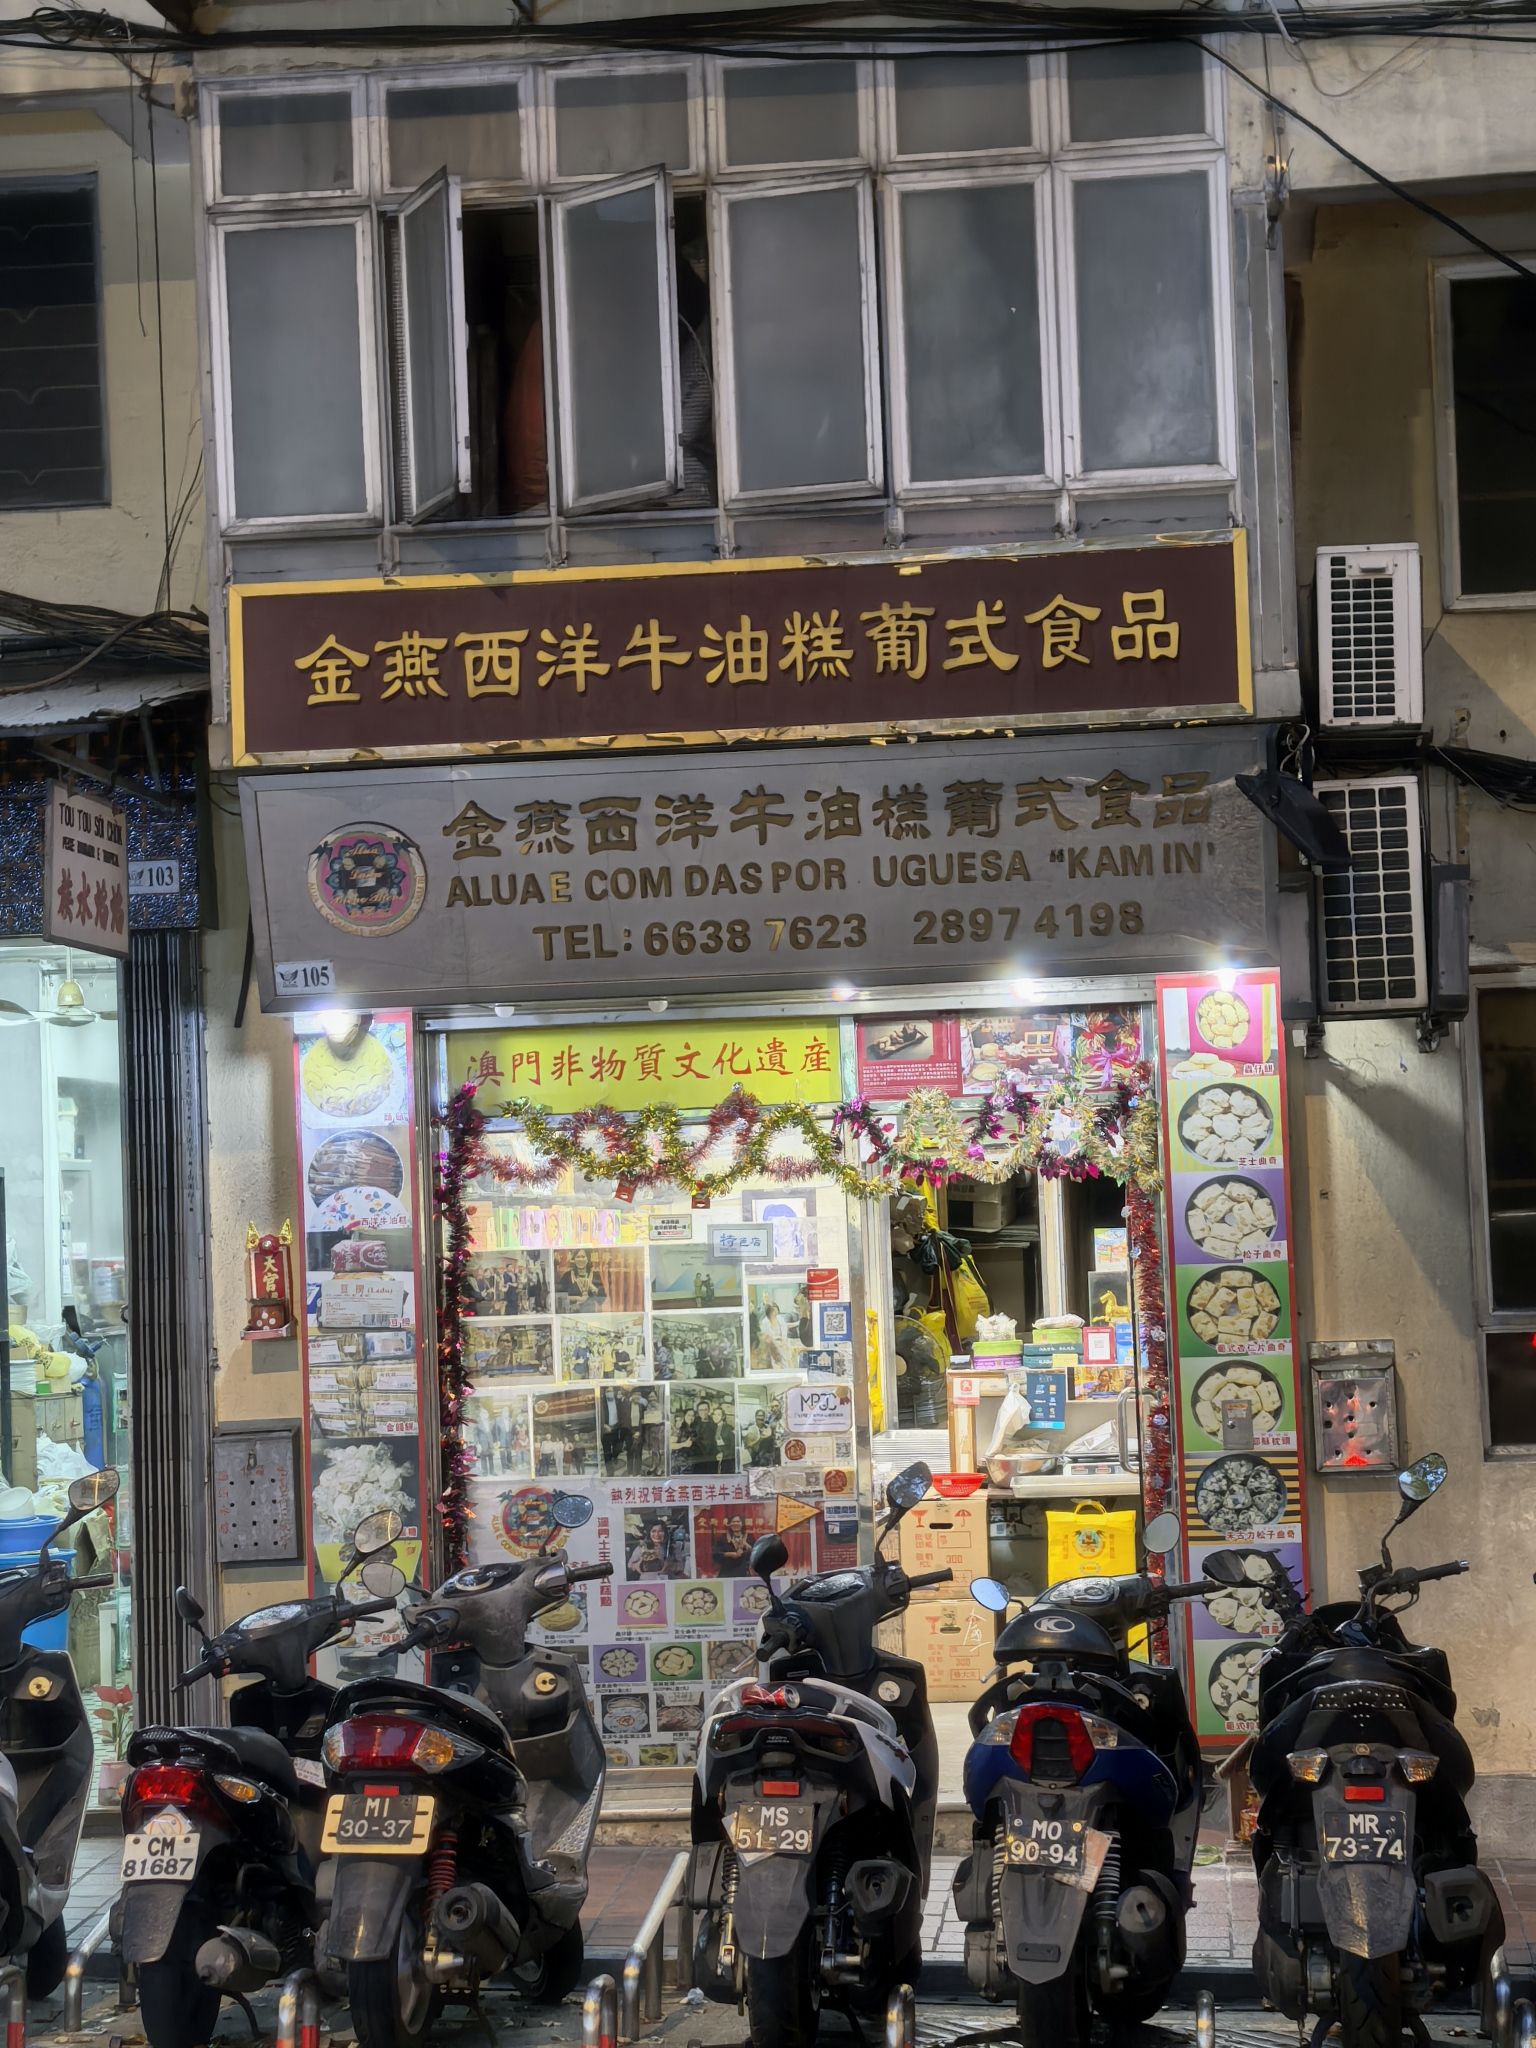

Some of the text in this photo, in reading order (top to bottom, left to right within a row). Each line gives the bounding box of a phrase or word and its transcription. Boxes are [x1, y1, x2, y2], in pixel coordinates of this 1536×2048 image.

[294, 588, 1181, 706] 金燕西洋牛油糕葡式食品
[147, 866, 174, 888] 103
[533, 901, 1145, 961] TEL: 6638 7623 2897 4198
[301, 966, 330, 988] 105
[760, 1806, 790, 1827] MS
[1349, 1813, 1380, 1835] MR
[339, 1819, 413, 1839] 30-37
[737, 1828, 808, 1851] 51-29
[1031, 1821, 1062, 1841] MO
[147, 1836, 177, 1856] CM
[1010, 1841, 1078, 1867] 90-94
[1326, 1837, 1405, 1861] 73-74
[122, 1858, 194, 1879] 81687
